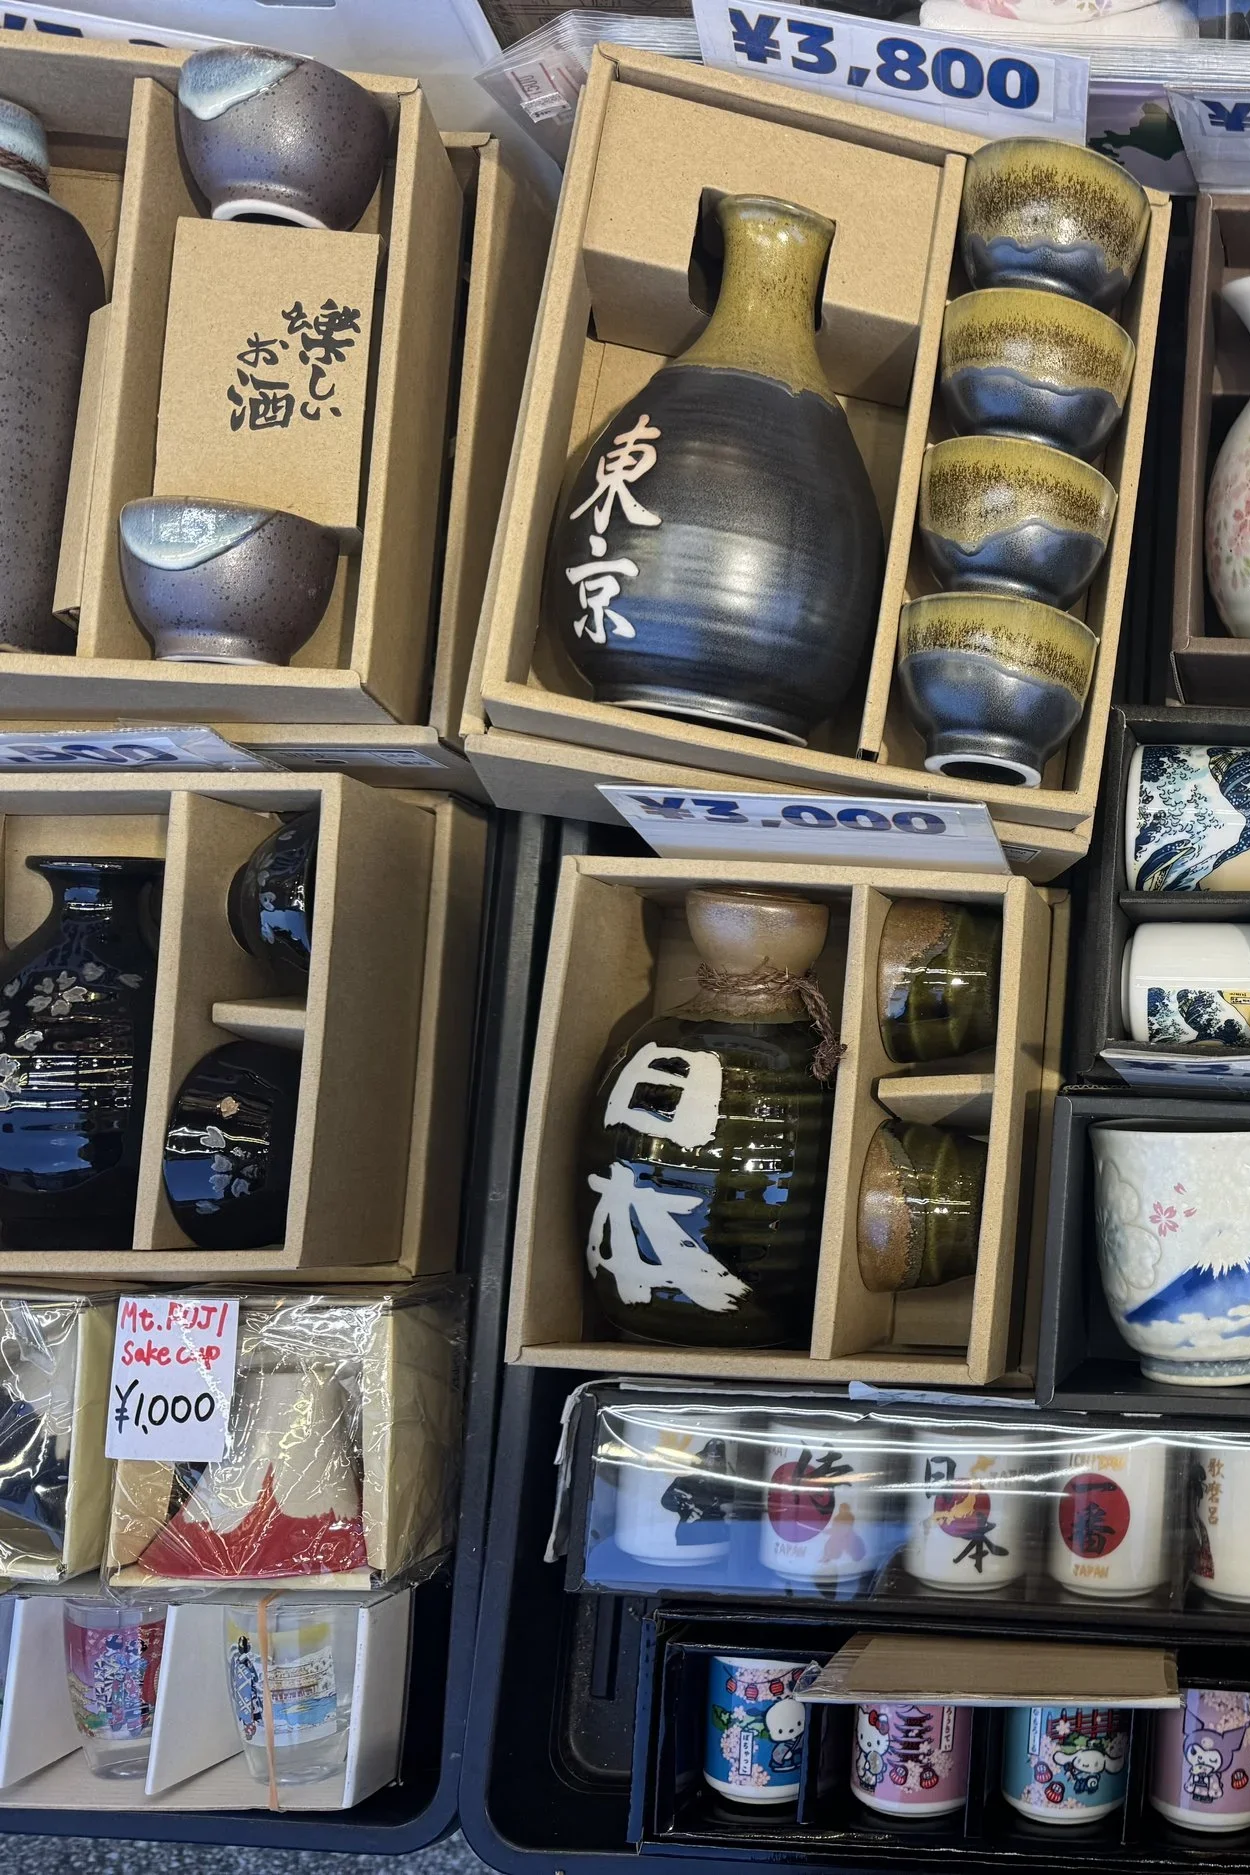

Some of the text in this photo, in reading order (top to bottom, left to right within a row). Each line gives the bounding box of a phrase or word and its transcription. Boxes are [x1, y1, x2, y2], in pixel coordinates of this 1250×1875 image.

[731, 8, 1040, 109] ¥3,800
[226, 331, 295, 432] お酒
[566, 413, 663, 645] 東京
[585, 1041, 753, 1314] 日本
[121, 1339, 221, 1371] Sake cup
[114, 1378, 216, 1435] ¥1,000
[924, 1455, 1010, 1574] 日本
[1068, 1481, 1118, 1555] 一番
[1073, 1563, 1110, 1579] JAPAN
